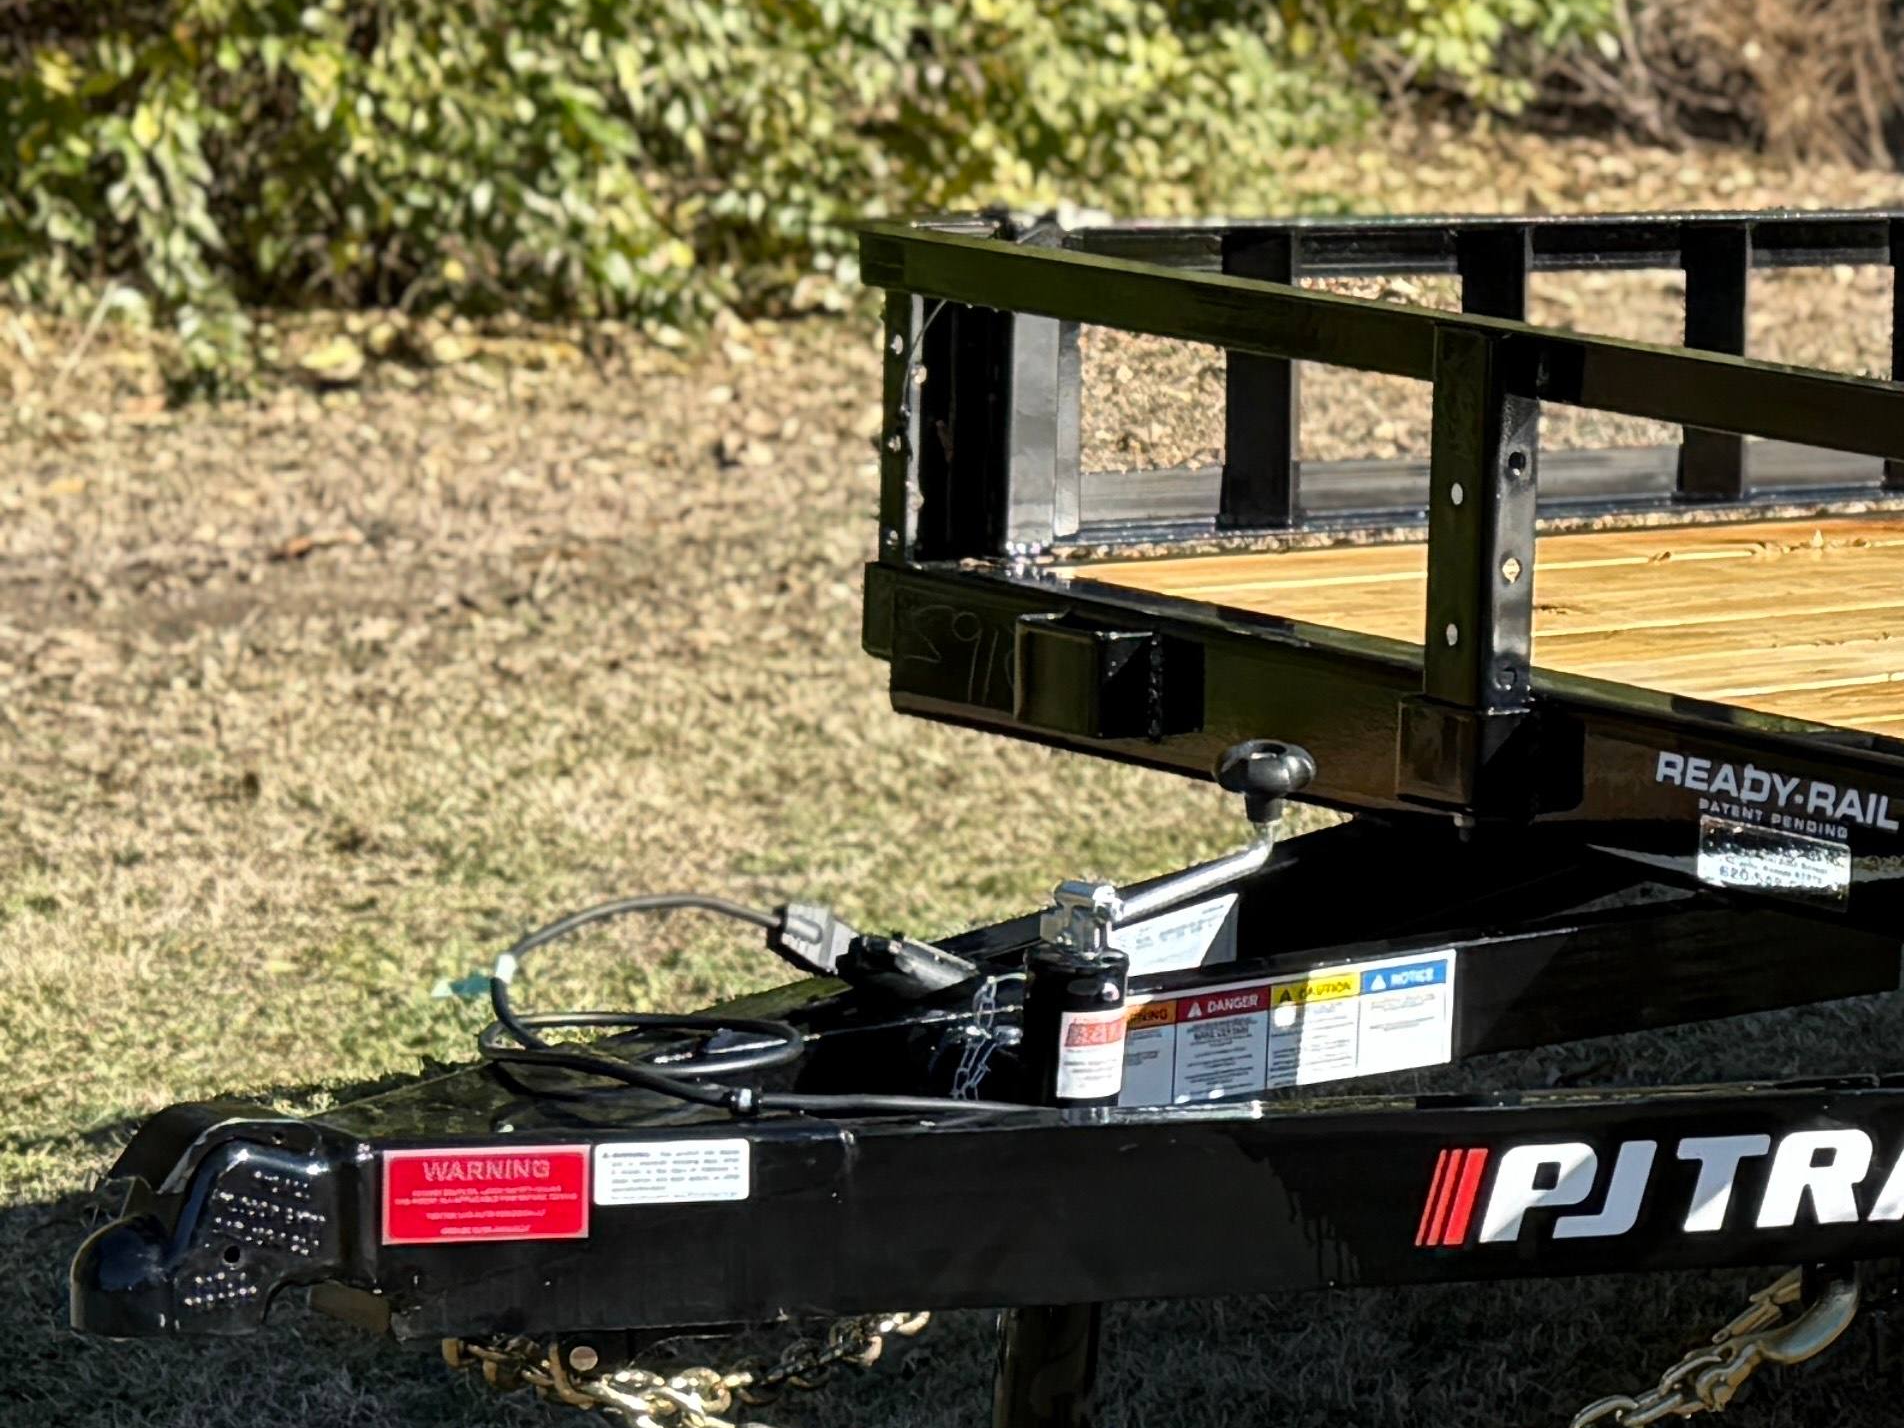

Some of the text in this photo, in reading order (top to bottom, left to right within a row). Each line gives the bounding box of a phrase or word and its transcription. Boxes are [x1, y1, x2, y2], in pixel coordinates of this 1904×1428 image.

[1699, 797, 1849, 840] PATENT PENDING
[1207, 994, 1259, 1014] DANGER
[422, 1158, 551, 1182] WARNING
[1479, 1139, 1657, 1244] PJ
